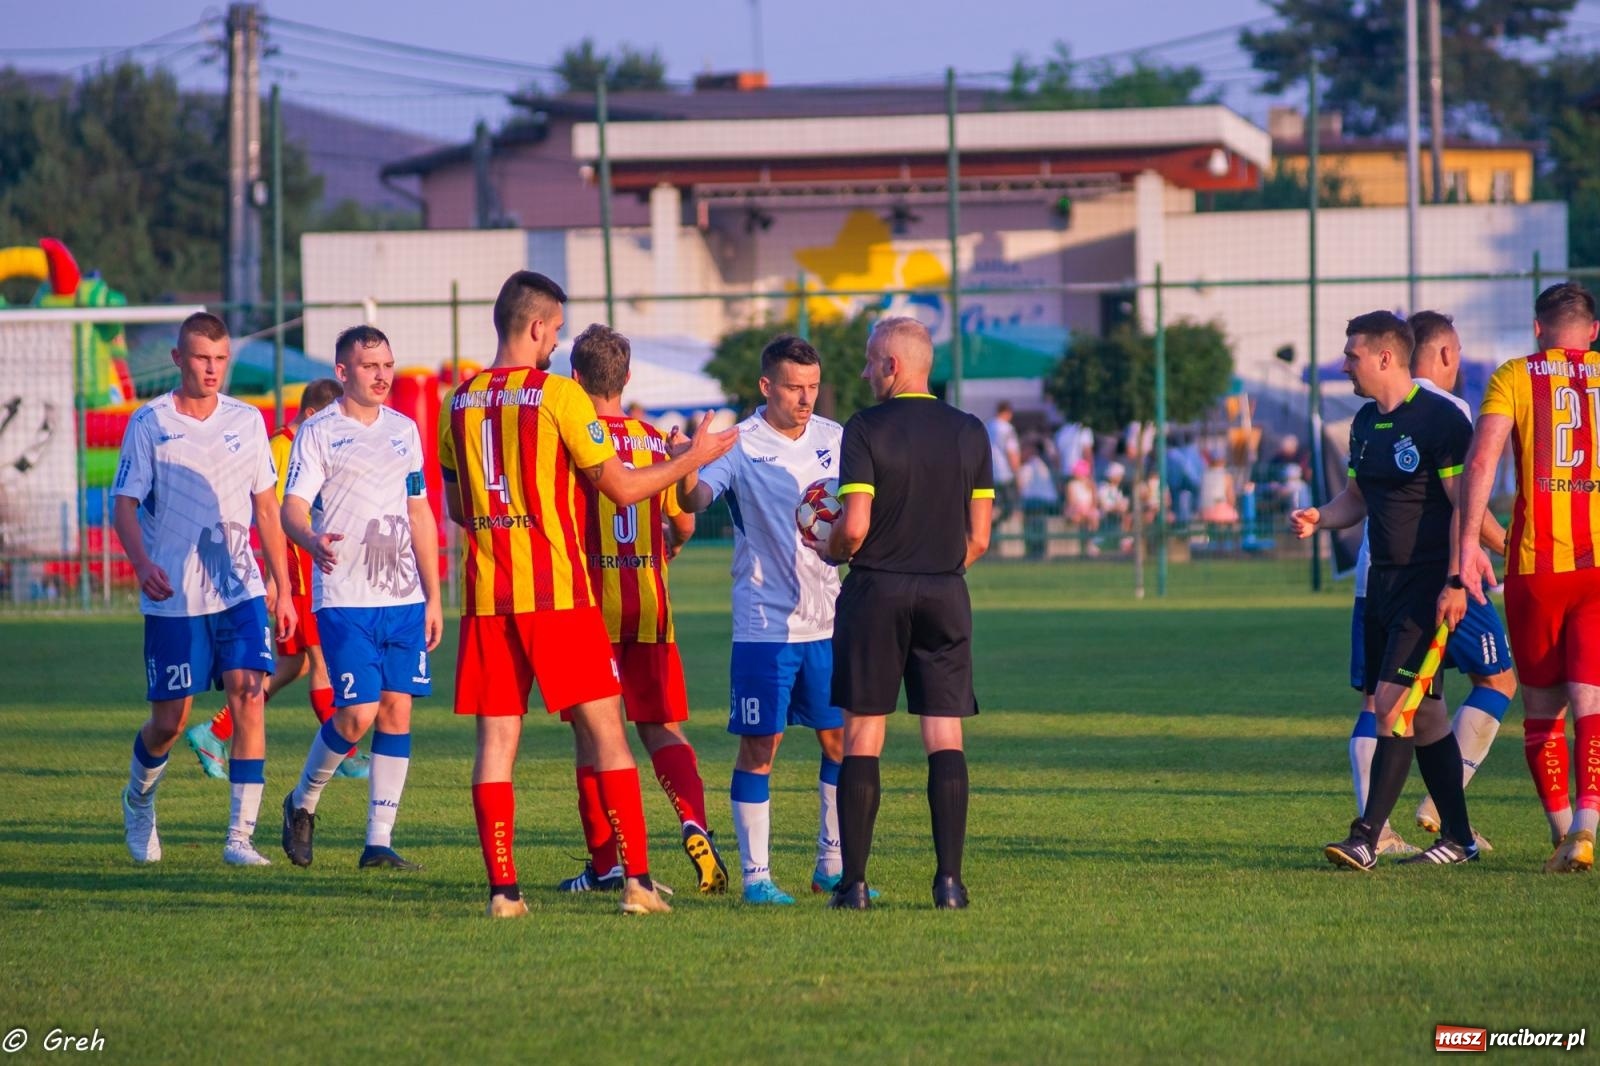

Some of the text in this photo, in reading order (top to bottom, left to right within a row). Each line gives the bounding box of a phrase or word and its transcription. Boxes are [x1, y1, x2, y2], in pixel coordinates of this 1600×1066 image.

[1577, 363, 1600, 379] POŁ
[166, 662, 192, 691] 20
[341, 672, 357, 699] 2
[741, 697, 760, 726] 18
[1544, 735, 1561, 791] OŁOMIA
[1587, 735, 1600, 791] OŁOMIA
